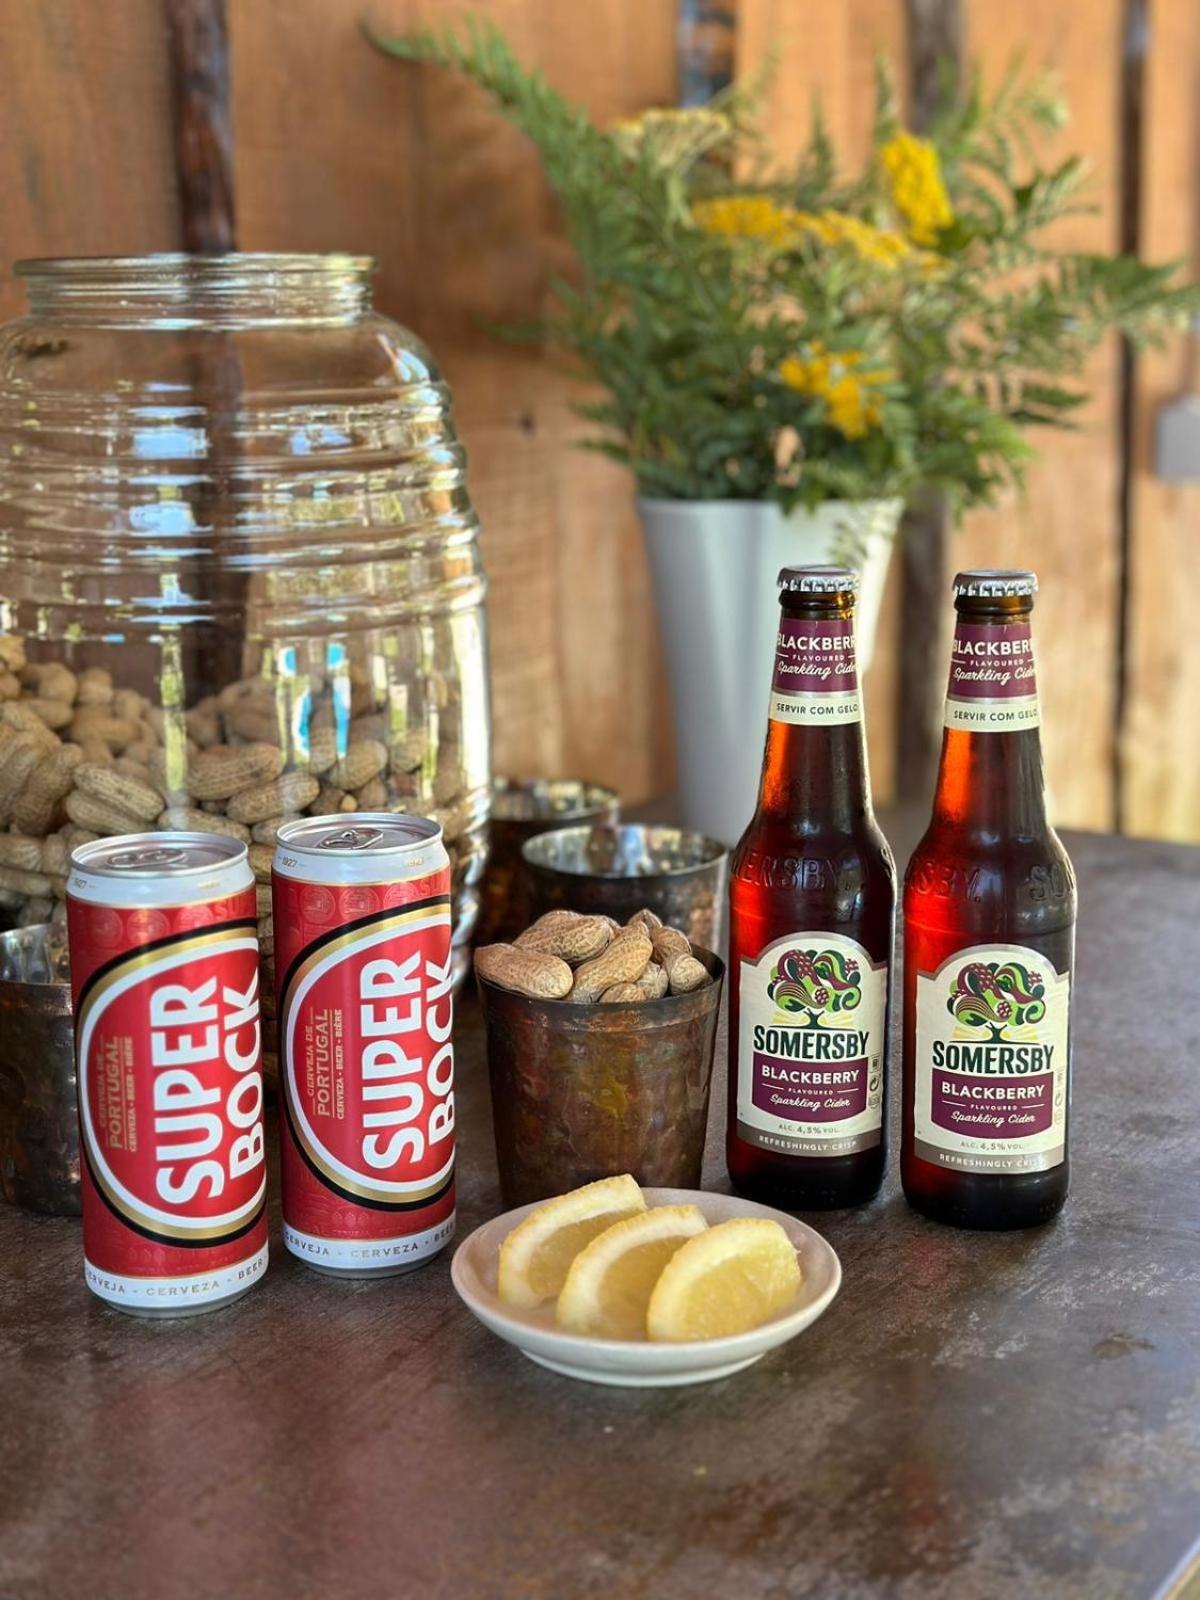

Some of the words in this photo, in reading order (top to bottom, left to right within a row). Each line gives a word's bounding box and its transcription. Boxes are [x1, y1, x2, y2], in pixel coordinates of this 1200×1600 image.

[792, 654, 845, 662] FLAVOURED
[970, 659, 1025, 667] FLAVOURED
[777, 660, 831, 681] Sparkling
[953, 667, 1011, 686] Sparkling
[776, 702, 807, 714] SERVIR
[809, 706, 834, 715] COM
[953, 710, 986, 721] SERVIR
[989, 712, 1015, 721] COM
[304, 1025, 314, 1042] DE
[753, 1024, 870, 1060] SOMERSBY
[335, 1045, 344, 1070] BEER
[360, 950, 425, 1169] SUPER
[425, 951, 456, 1147] BOCK
[932, 1040, 1055, 1075] SOMERSBY
[222, 966, 265, 1180] BOCK
[305, 1045, 316, 1097] CERVEJA
[315, 1008, 331, 1117] PORTUGAL
[761, 1064, 860, 1085] BLACKBERRY
[105, 1036, 123, 1149] PORTUGAL
[149, 975, 225, 1204] SUPER
[335, 1077, 345, 1120] CERVEZA
[788, 1087, 834, 1095] FLAVOURED
[941, 1081, 1046, 1100] BLACKBERRY
[769, 1093, 821, 1112] Sparkling
[823, 1098, 851, 1108] Cider
[970, 1103, 1028, 1111] FLAVOURED
[950, 1110, 1006, 1128] Sparkling
[1007, 1112, 1036, 1124] Cider
[125, 1107, 137, 1153] CERVEZA
[759, 1135, 829, 1151] REFRESHINGLY
[831, 1140, 857, 1151] CRISP
[939, 1153, 1013, 1169] REFRESHINGLY
[350, 1242, 419, 1259] CERVEZA
[146, 1279, 220, 1297] CERVEZA
[238, 1256, 264, 1280] BEER
